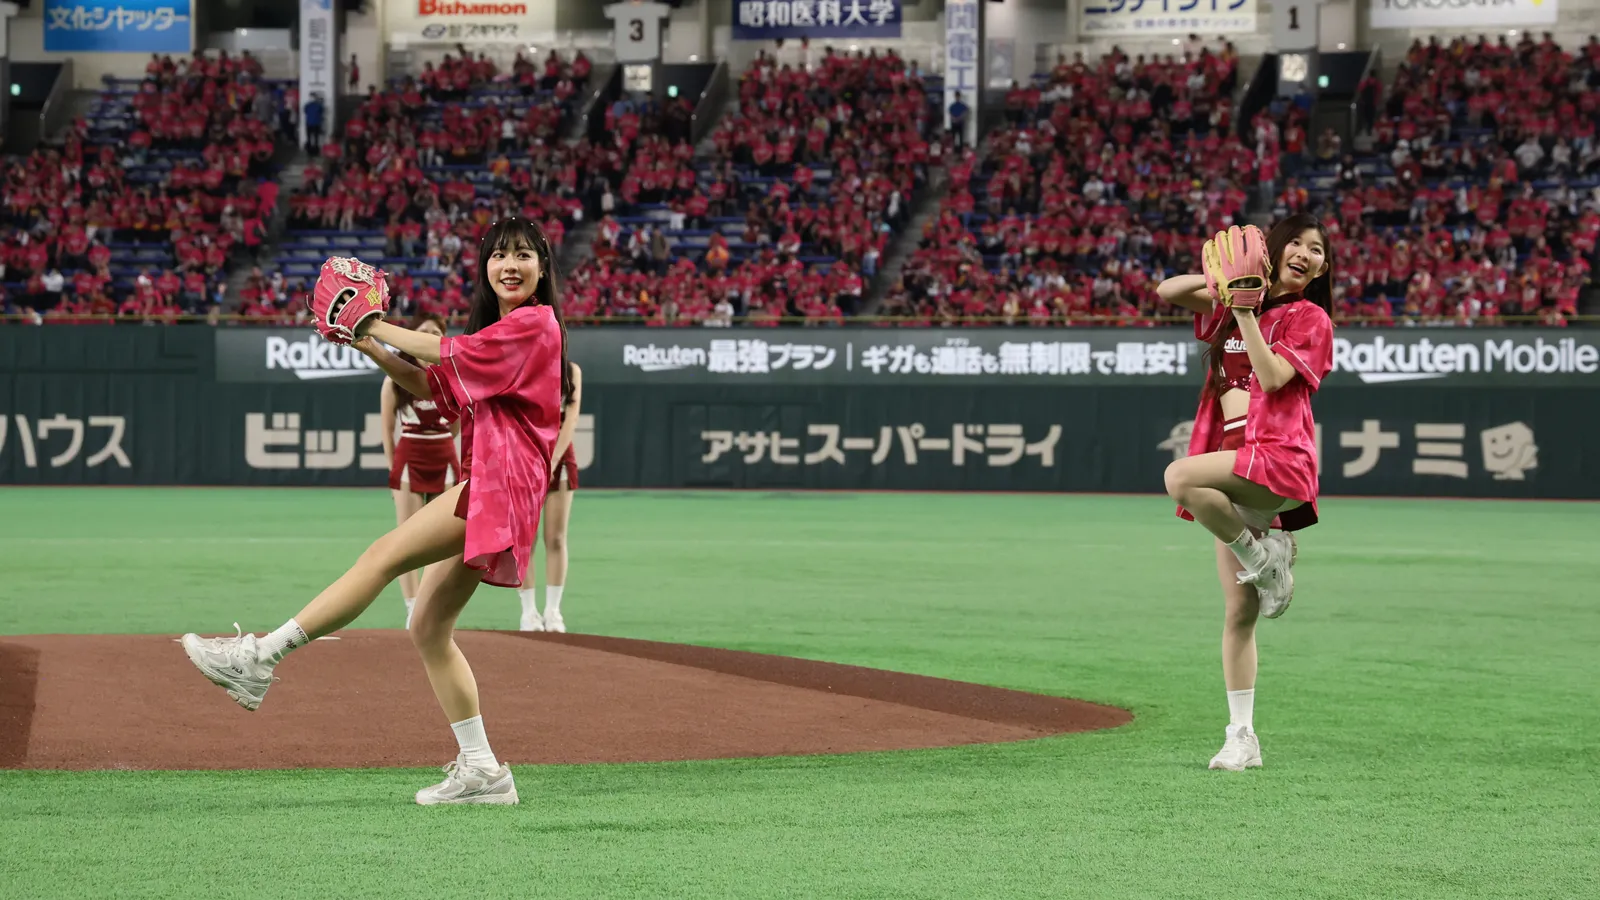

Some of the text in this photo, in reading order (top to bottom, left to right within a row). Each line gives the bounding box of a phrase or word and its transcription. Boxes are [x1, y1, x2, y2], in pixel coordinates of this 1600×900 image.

[48, 6, 188, 31] 文化シャッター
[418, 0, 527, 15] Bishamon
[739, 0, 895, 27] 昭和医科大学
[1288, 6, 1300, 30] 1
[629, 18, 644, 42] 3
[266, 335, 400, 369] Rakut
[623, 344, 705, 366] Rakuten
[707, 339, 836, 373] 最強プラン
[1333, 336, 1599, 373] Rakuten Mobile
[701, 423, 1062, 467] アサヒスーパードライ
[1314, 419, 1468, 478] ナミ
